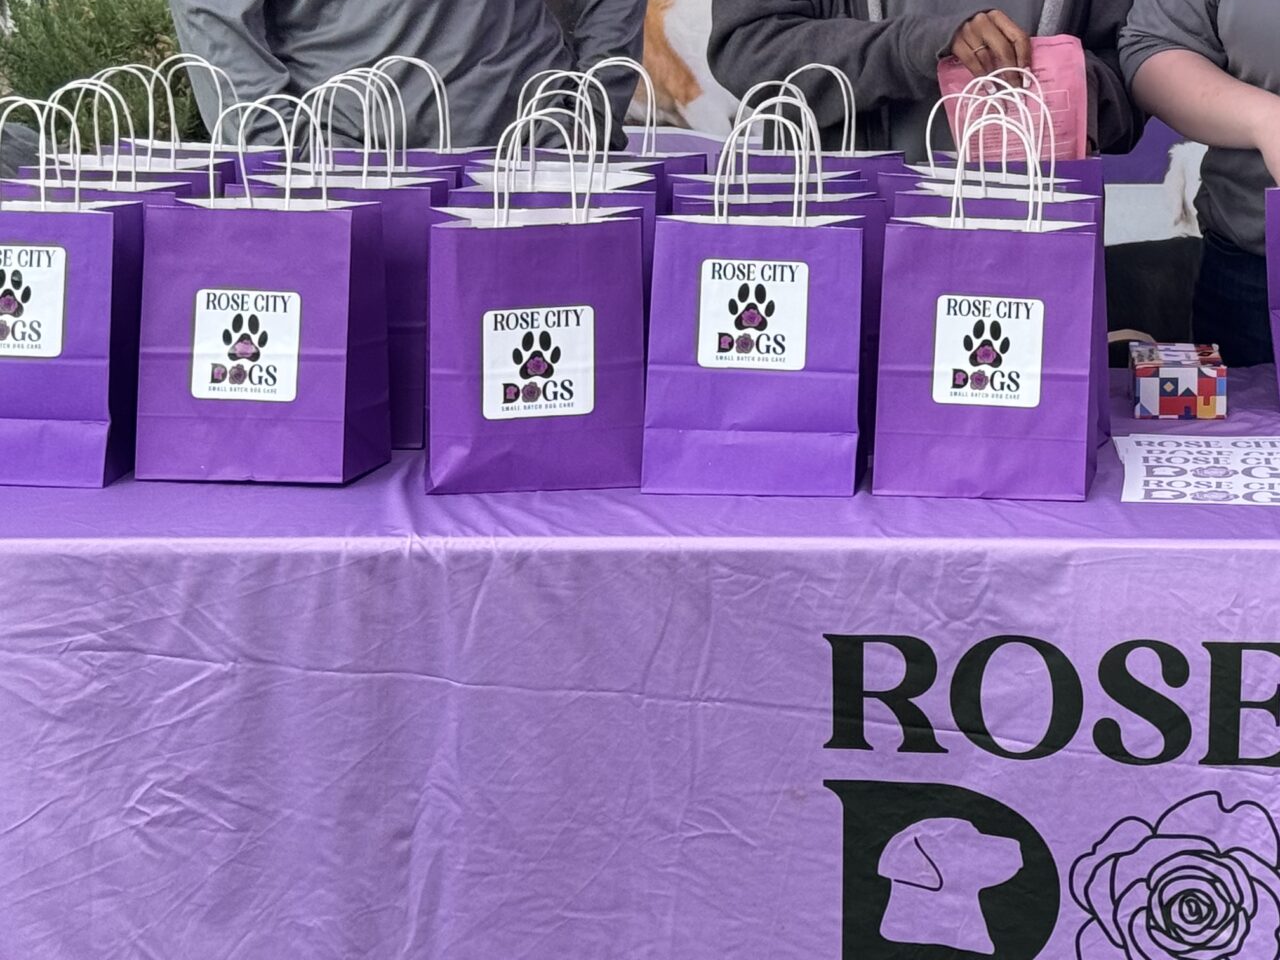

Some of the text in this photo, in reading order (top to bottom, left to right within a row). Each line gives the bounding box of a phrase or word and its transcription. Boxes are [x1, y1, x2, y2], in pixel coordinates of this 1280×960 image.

[17, 249, 56, 268] CITY
[711, 262, 799, 282] ROSE CITY
[206, 292, 291, 313] ROSE CITY
[946, 298, 1034, 320] ROSE CITY
[493, 309, 584, 331] ROSE CITY
[1134, 440, 1222, 449] ROSE
[1142, 456, 1231, 465] ROSE
[1143, 480, 1233, 490] ROSE
